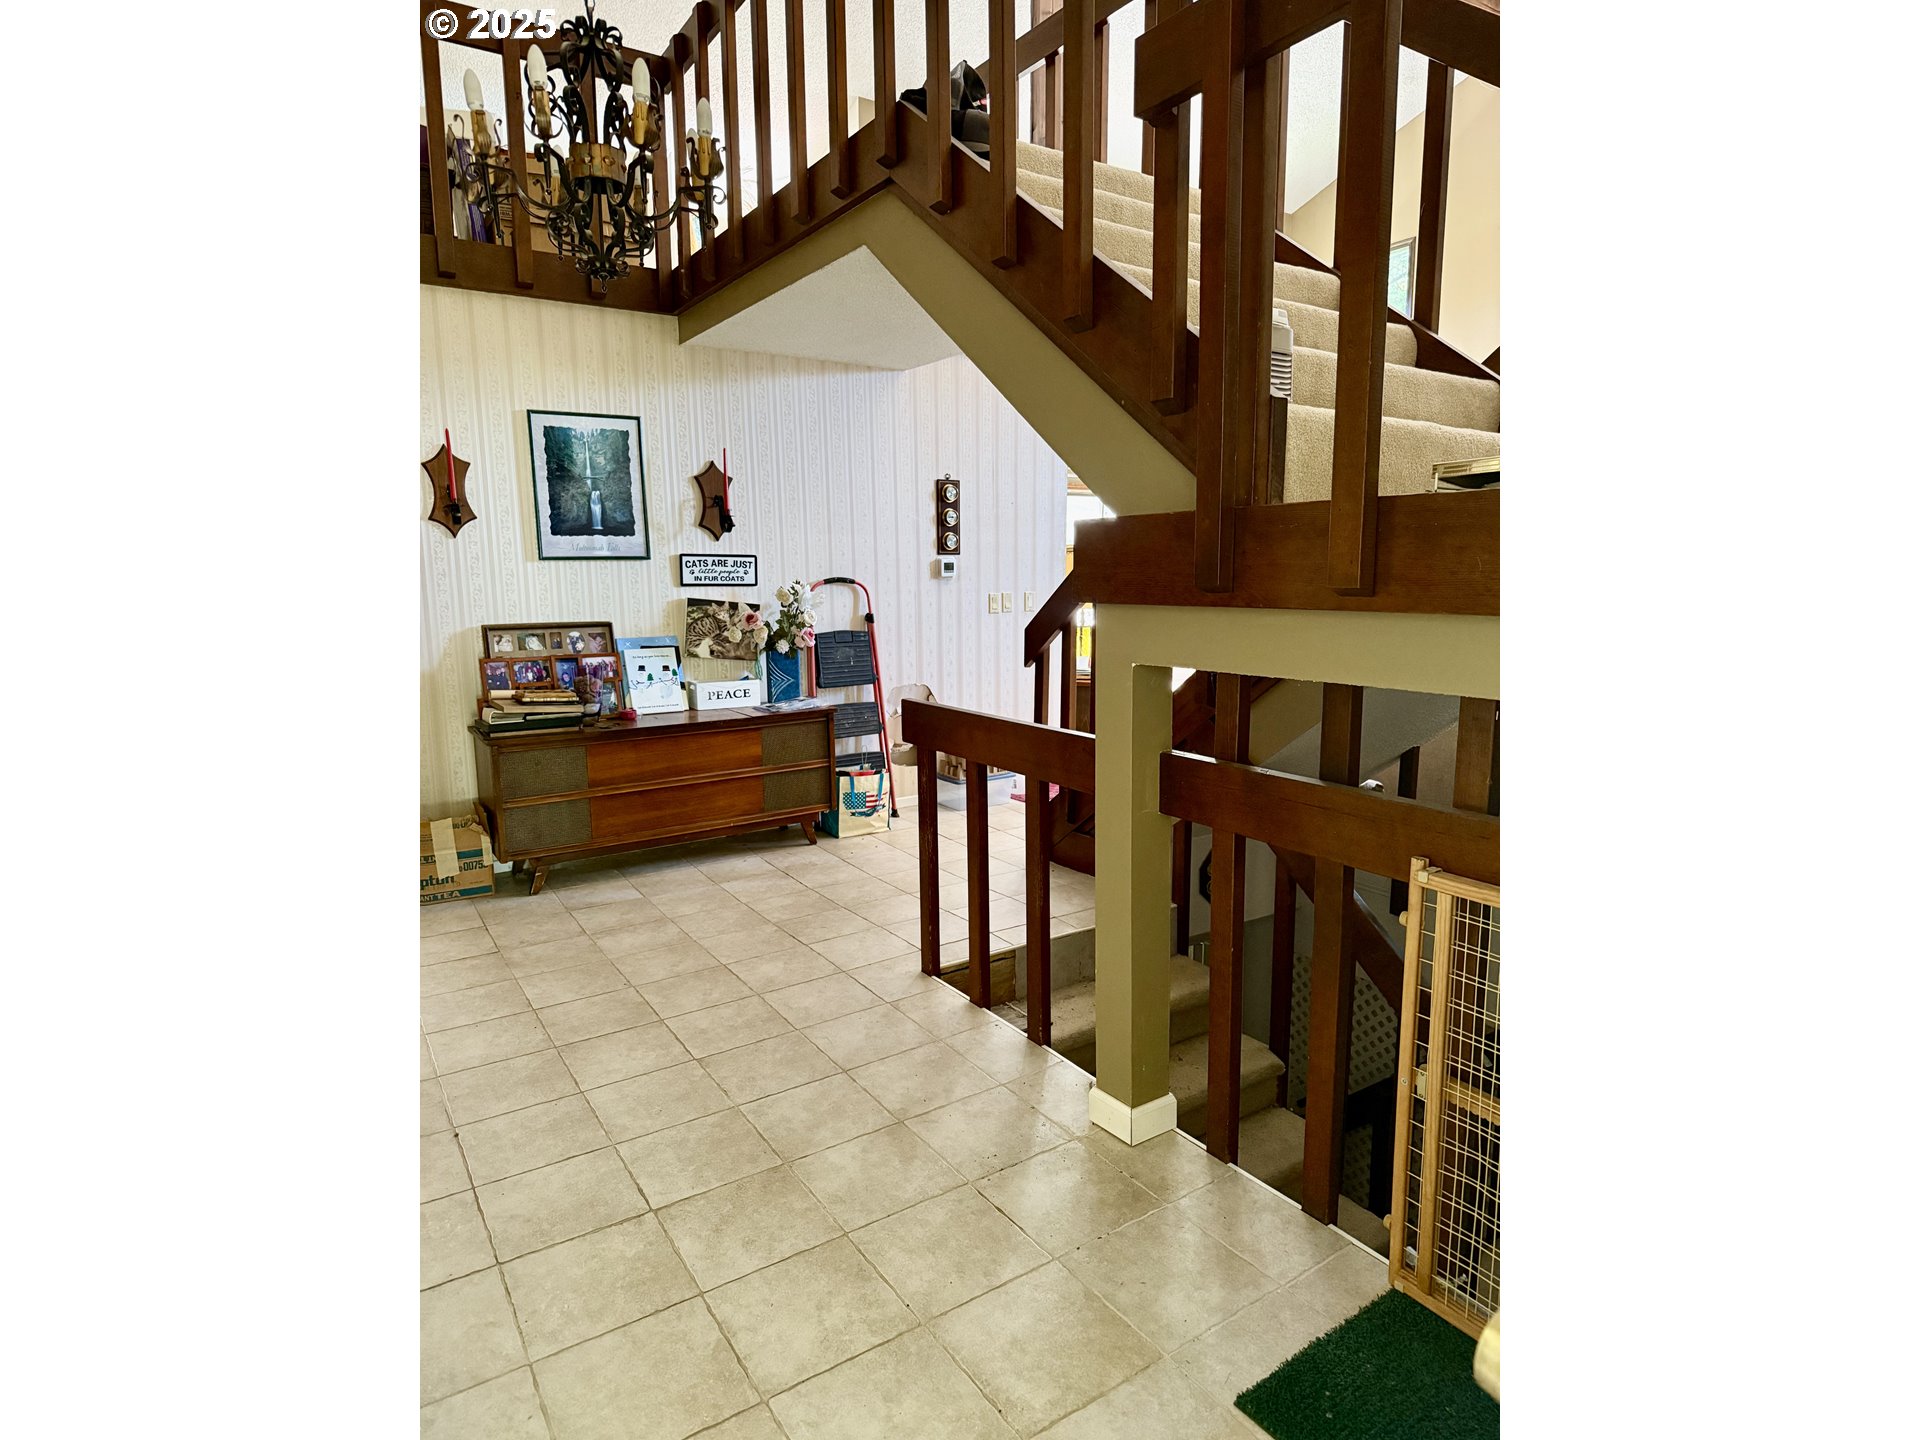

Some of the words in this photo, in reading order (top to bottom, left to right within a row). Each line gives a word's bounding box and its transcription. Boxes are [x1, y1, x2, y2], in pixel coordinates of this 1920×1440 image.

[685, 559, 709, 569] CATS
[711, 559, 729, 568] ARE
[730, 560, 753, 569] JUST
[698, 567, 718, 575] little
[718, 568, 741, 576] people
[707, 688, 752, 701] PEACE
[436, 890, 461, 899] TEA
